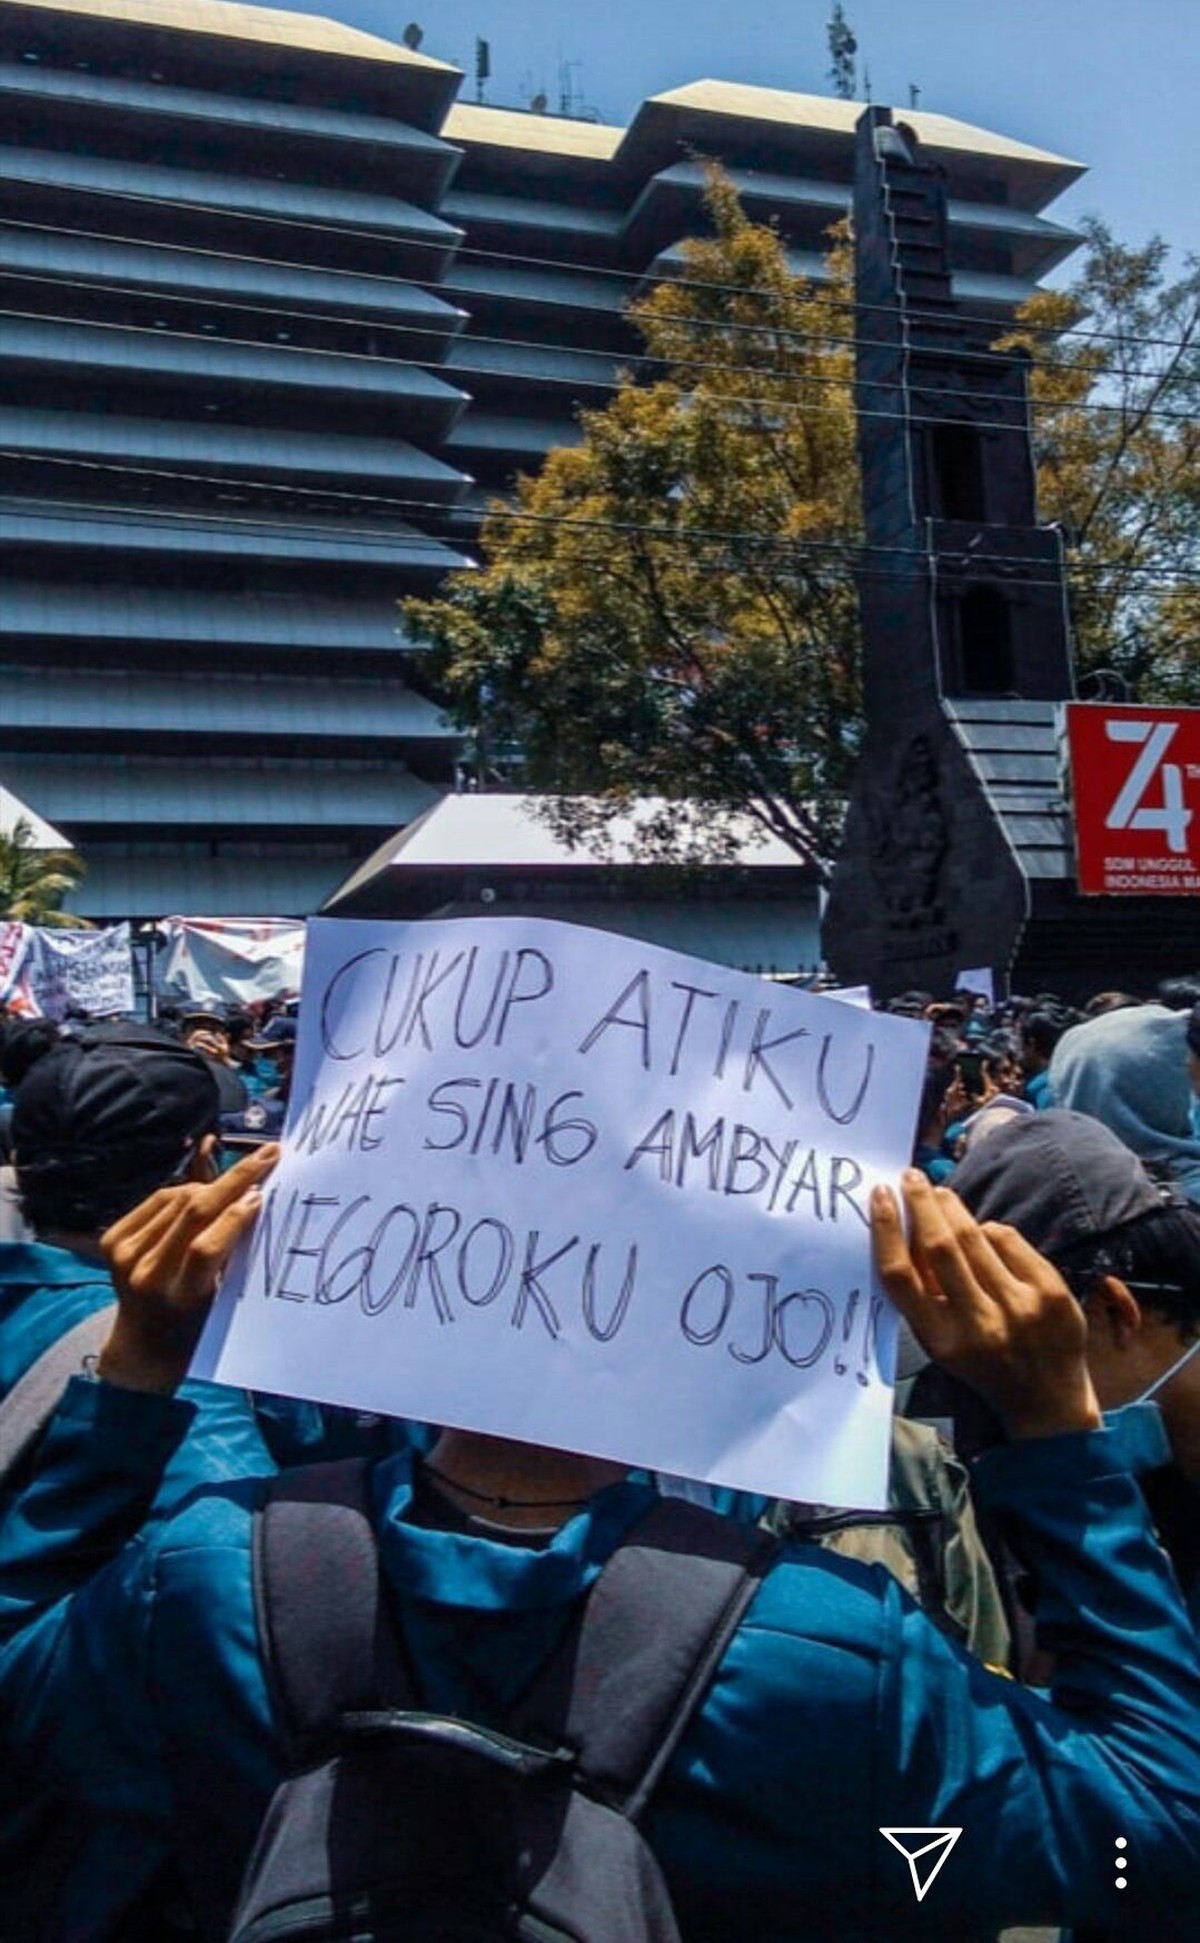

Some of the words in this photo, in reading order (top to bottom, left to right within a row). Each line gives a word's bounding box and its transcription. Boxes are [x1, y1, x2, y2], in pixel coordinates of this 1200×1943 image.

[1105, 719, 1193, 853] 74
[1104, 874, 1180, 888] INDONESIA
[319, 946, 554, 1061] CUKUP
[578, 969, 874, 1125] ATIKU
[294, 1074, 405, 1155] WAE
[422, 1077, 598, 1166] SING
[624, 1108, 872, 1229] AMBYAR
[252, 1184, 637, 1342] NEGOROKU
[680, 1263, 884, 1388] OJO!!
